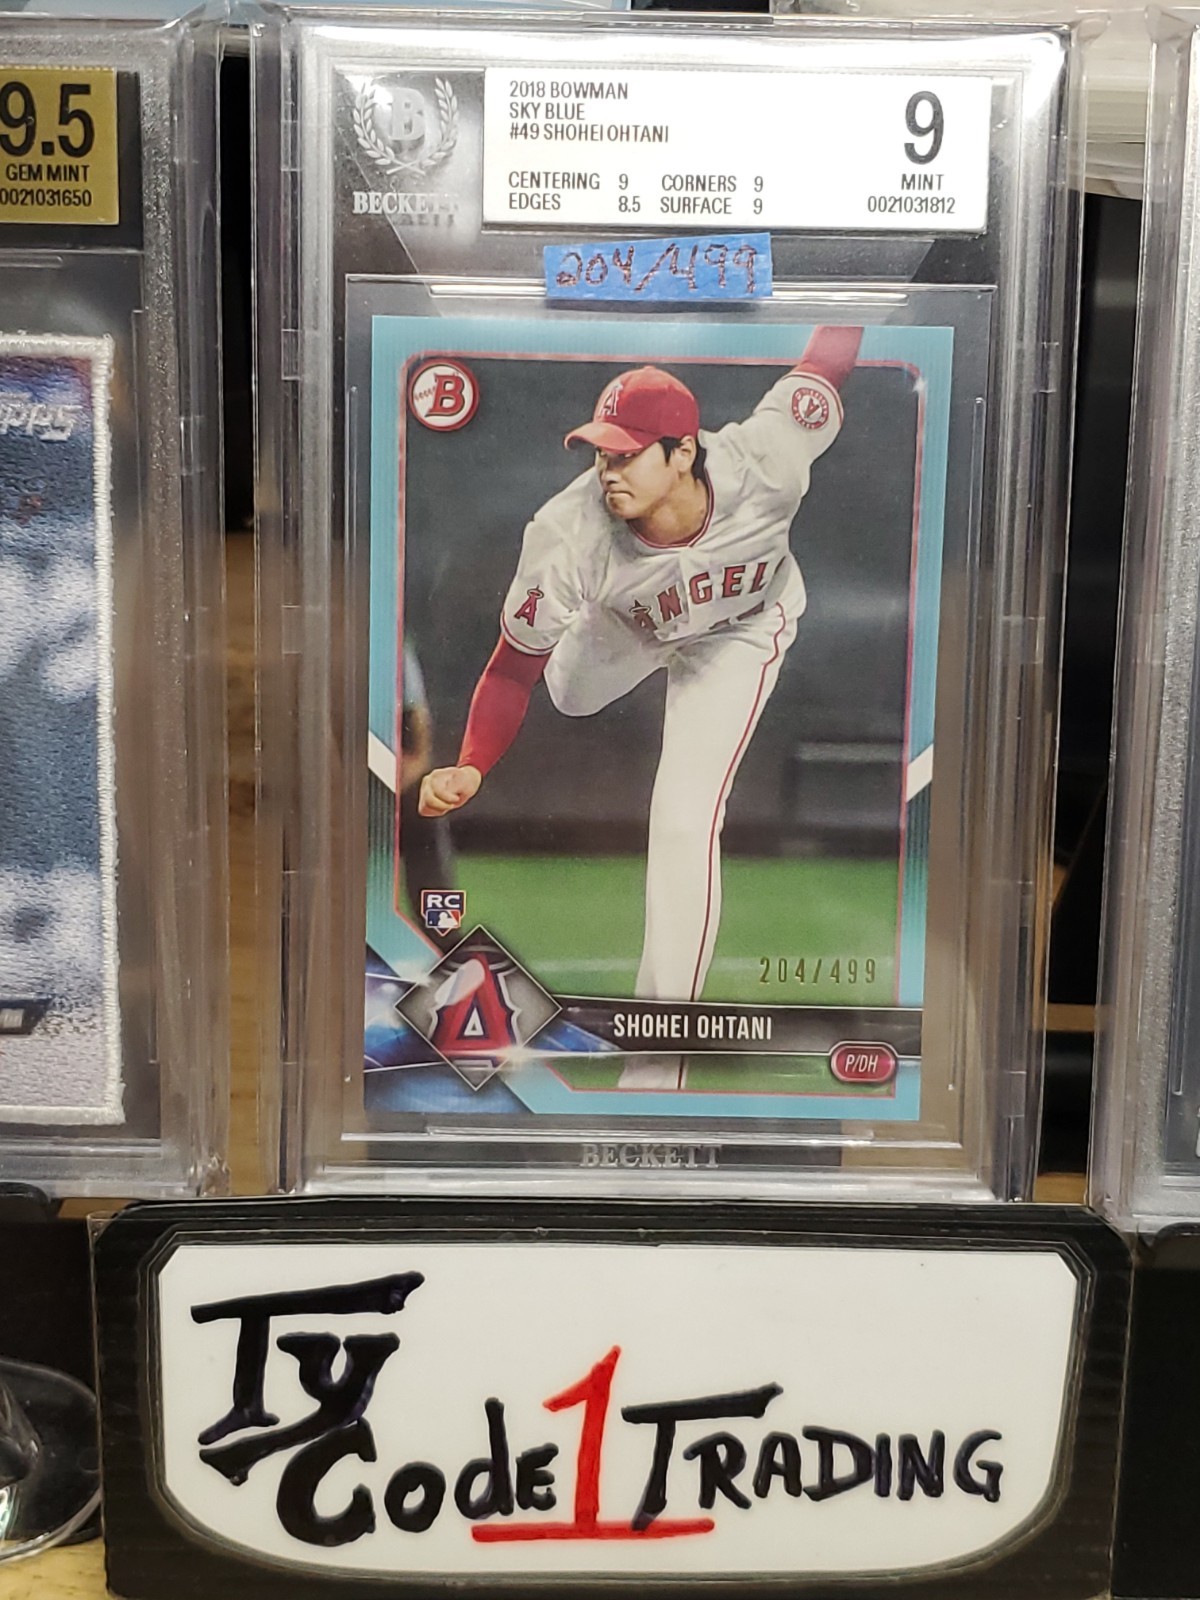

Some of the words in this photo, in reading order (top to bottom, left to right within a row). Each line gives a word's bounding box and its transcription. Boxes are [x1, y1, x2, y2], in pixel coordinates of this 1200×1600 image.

[509, 80, 546, 99] 2018
[550, 81, 629, 101] BOWMAN
[0, 81, 95, 158] 9.5
[509, 102, 542, 121] SKY
[545, 102, 585, 121] BLUE
[509, 123, 540, 141] #49
[543, 124, 604, 142] SHOHEI
[607, 125, 669, 144] OHTANI
[903, 90, 945, 166] 9
[5, 163, 43, 182] GEM
[46, 164, 90, 182] MINT
[508, 171, 601, 190] CENTERING
[618, 174, 629, 190] 9
[661, 174, 738, 193] CORNERS
[754, 176, 764, 193] 9
[901, 174, 945, 191] MINT
[0, 187, 93, 208] 0021031650
[352, 191, 461, 215] BECKET
[508, 193, 562, 211] EDGES
[618, 196, 642, 213] 8.5
[660, 197, 733, 215] SURFACE
[753, 198, 764, 215] 9
[867, 196, 956, 214] 0021031812
[556, 243, 758, 294] 204/499
[629, 556, 787, 633] ANGEL
[426, 894, 461, 909] RC
[759, 956, 877, 985] 204/499
[613, 1013, 690, 1038] SHOHEI
[696, 1015, 773, 1041] OHTANI
[844, 1053, 879, 1074] P/DH
[579, 1142, 723, 1168] BECKETT
